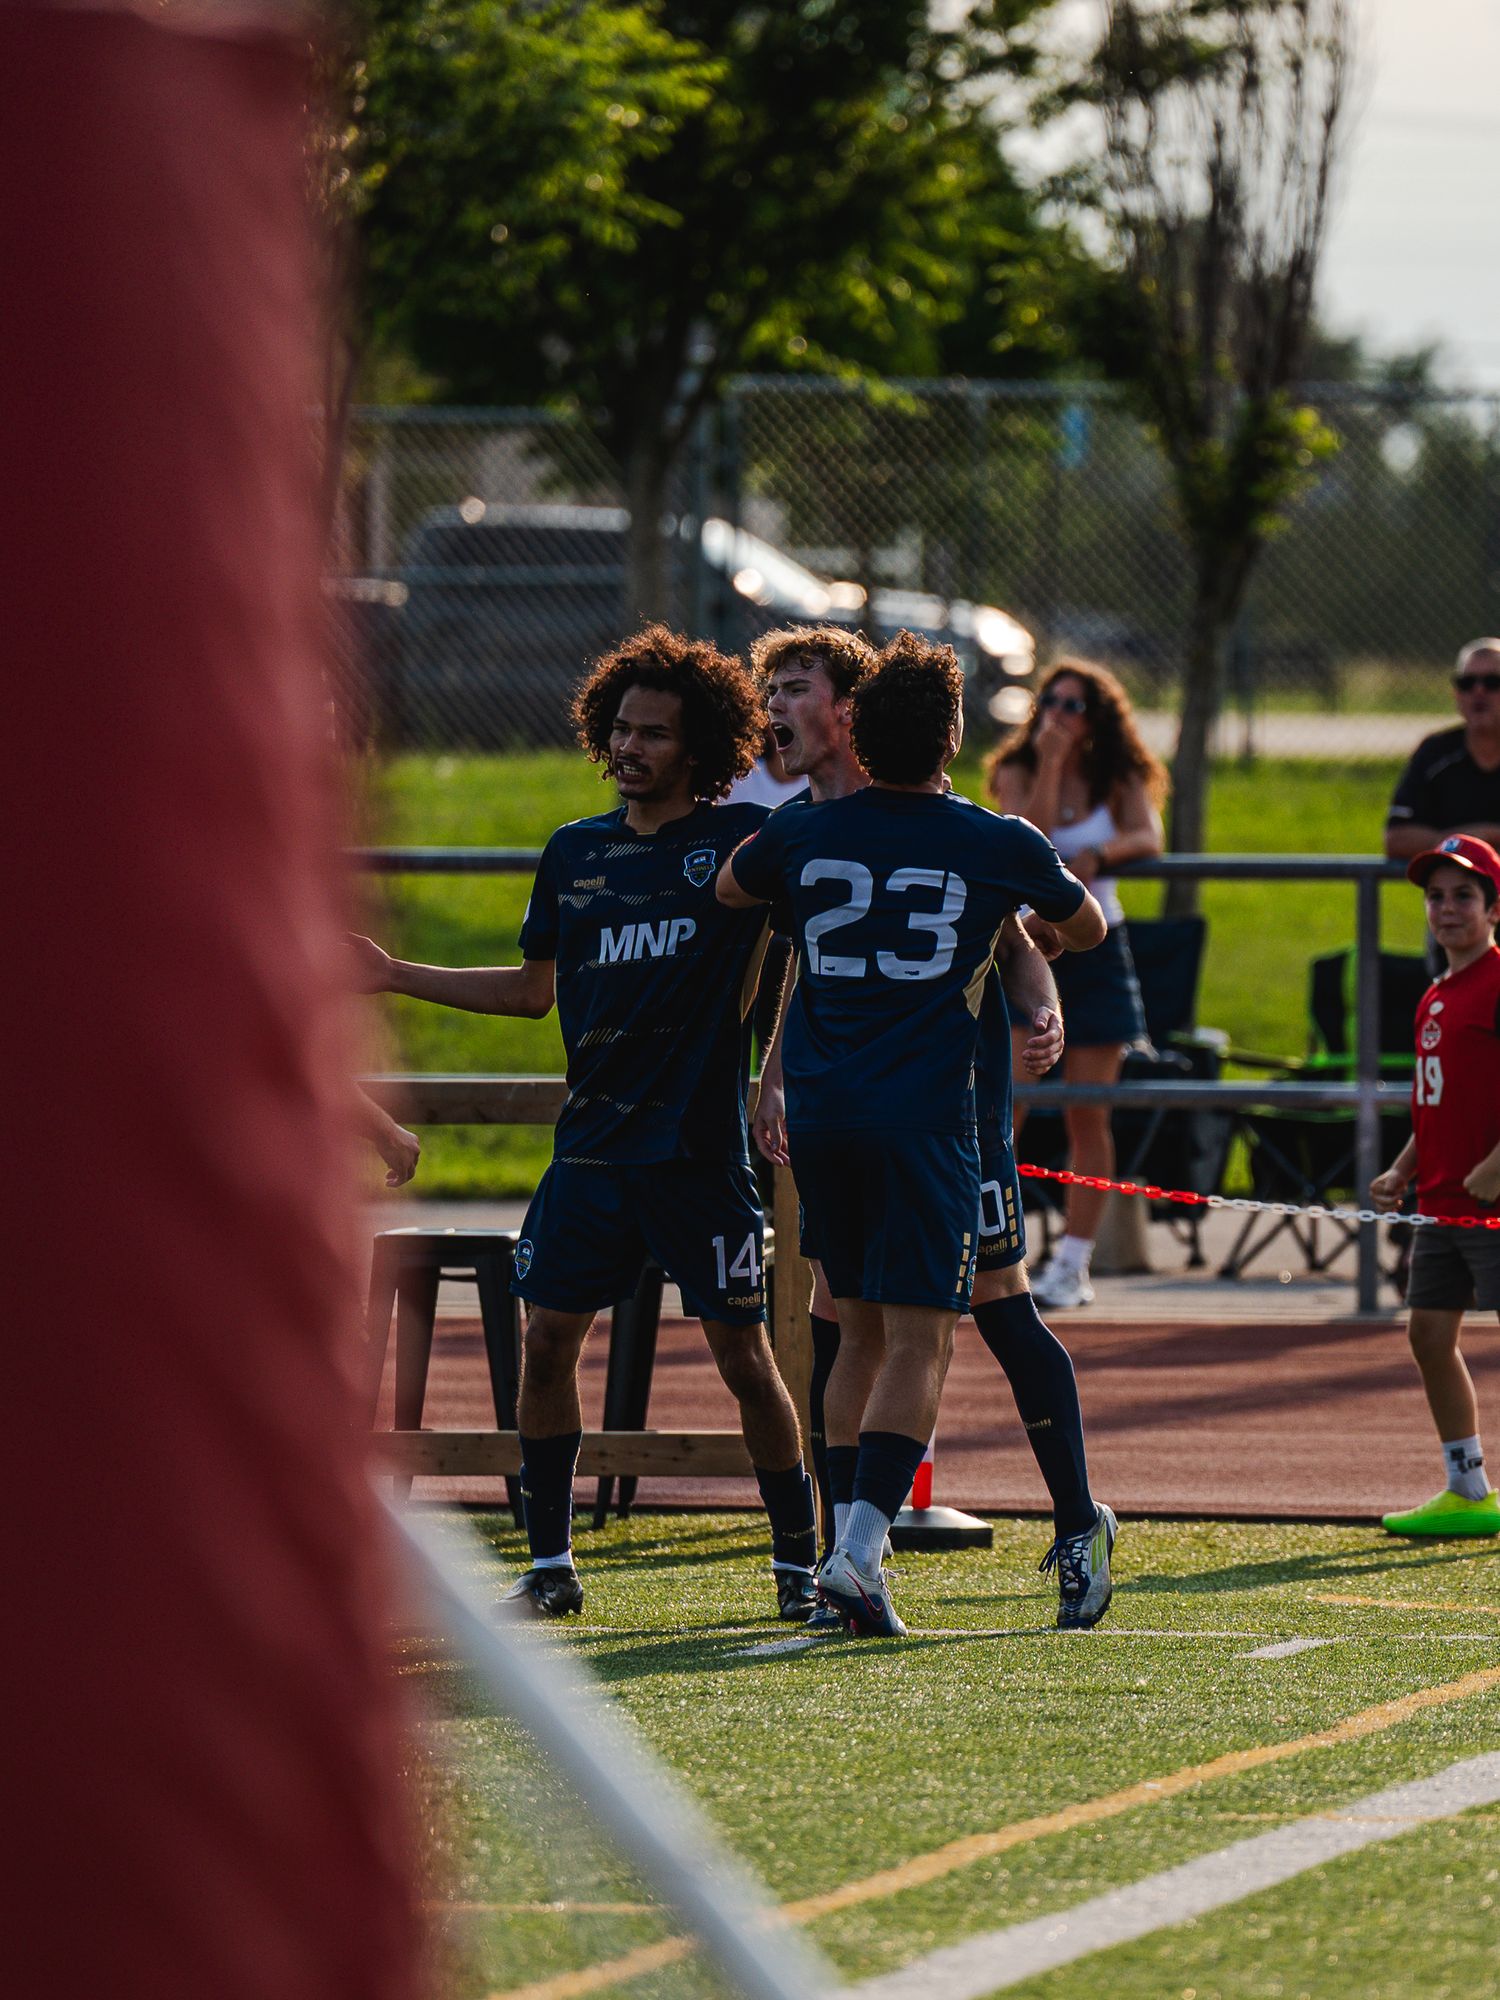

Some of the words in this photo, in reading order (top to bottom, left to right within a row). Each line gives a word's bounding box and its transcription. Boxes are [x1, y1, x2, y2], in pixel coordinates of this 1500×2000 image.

[599, 918, 696, 964] MNP
[800, 858, 967, 980] 23
[1416, 1056, 1444, 1106] 19
[712, 1232, 761, 1289] 14
[727, 1292, 761, 1308] capelli
